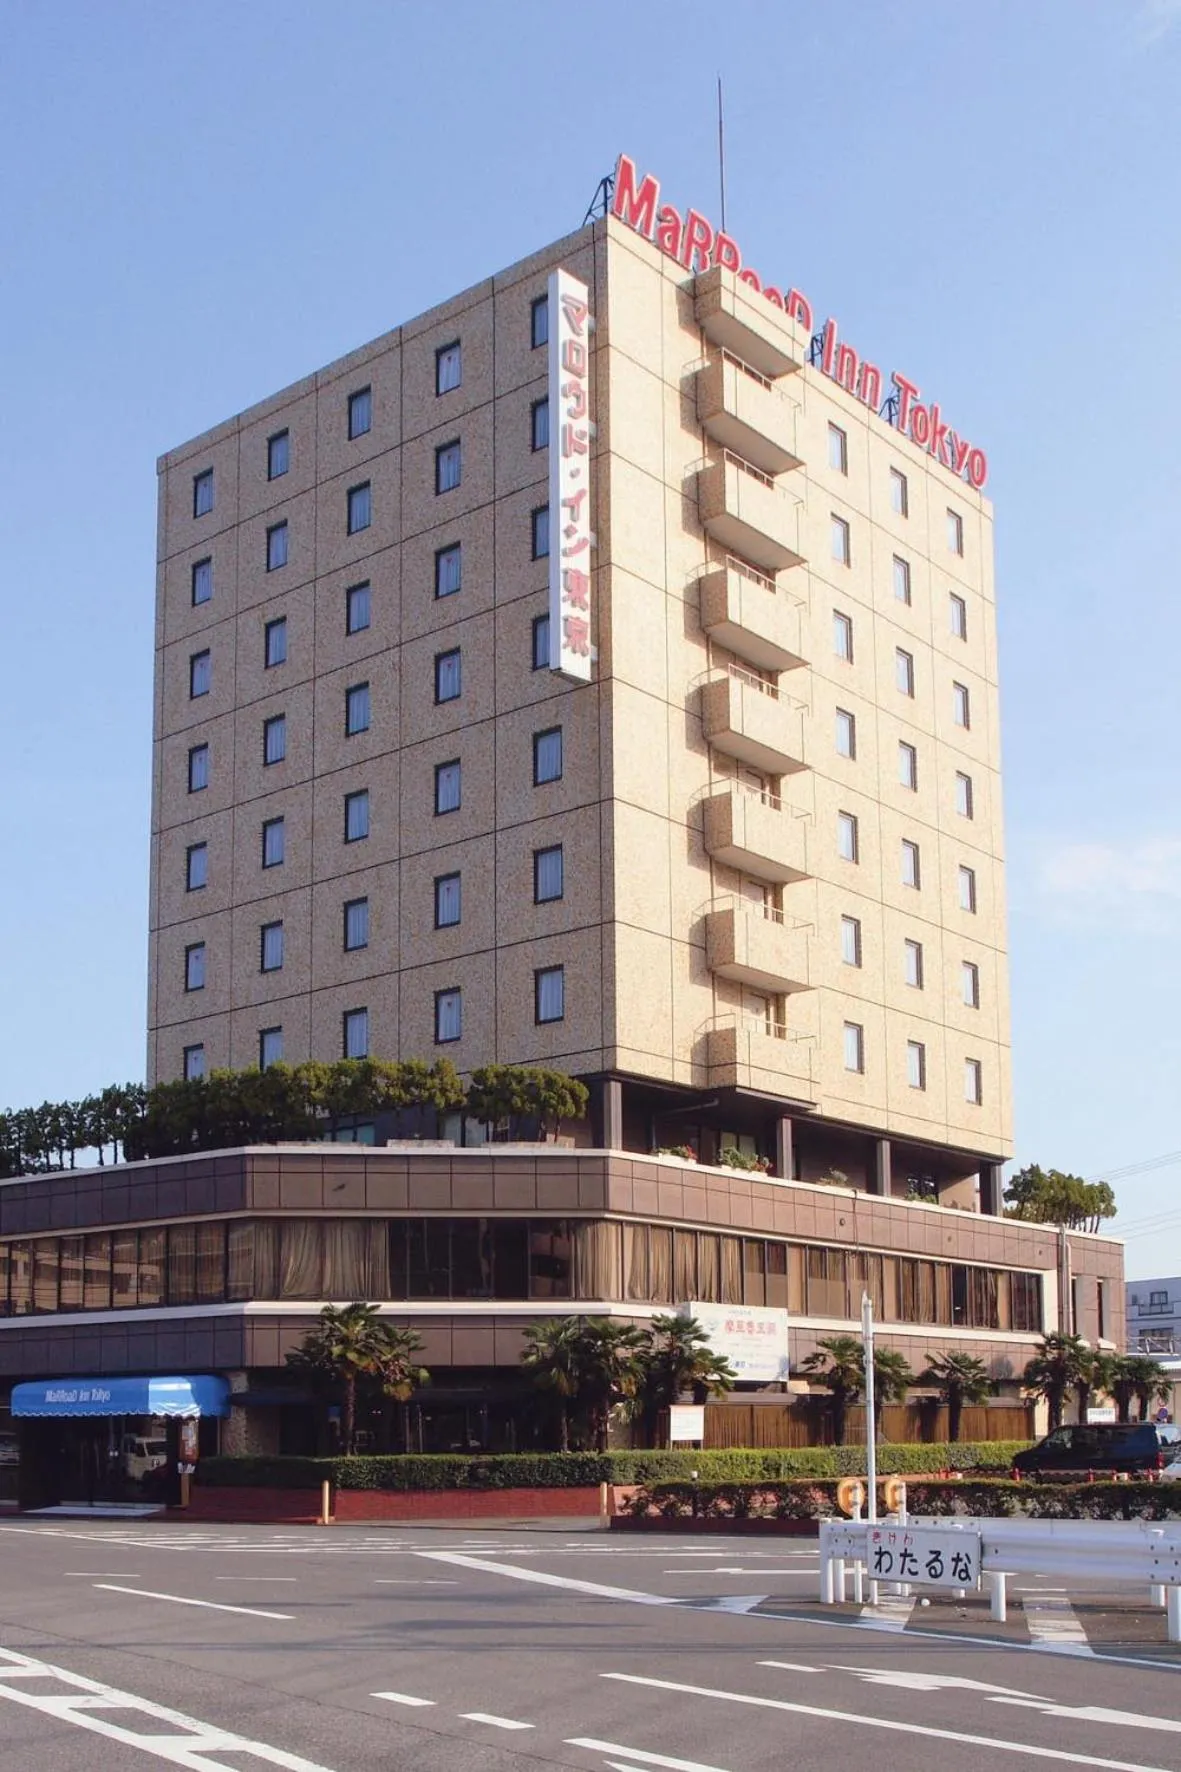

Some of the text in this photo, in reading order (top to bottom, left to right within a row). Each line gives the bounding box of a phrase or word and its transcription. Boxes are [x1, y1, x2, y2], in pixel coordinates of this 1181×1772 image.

[821, 318, 883, 415] Inn
[874, 1546, 972, 1581] わたるな
